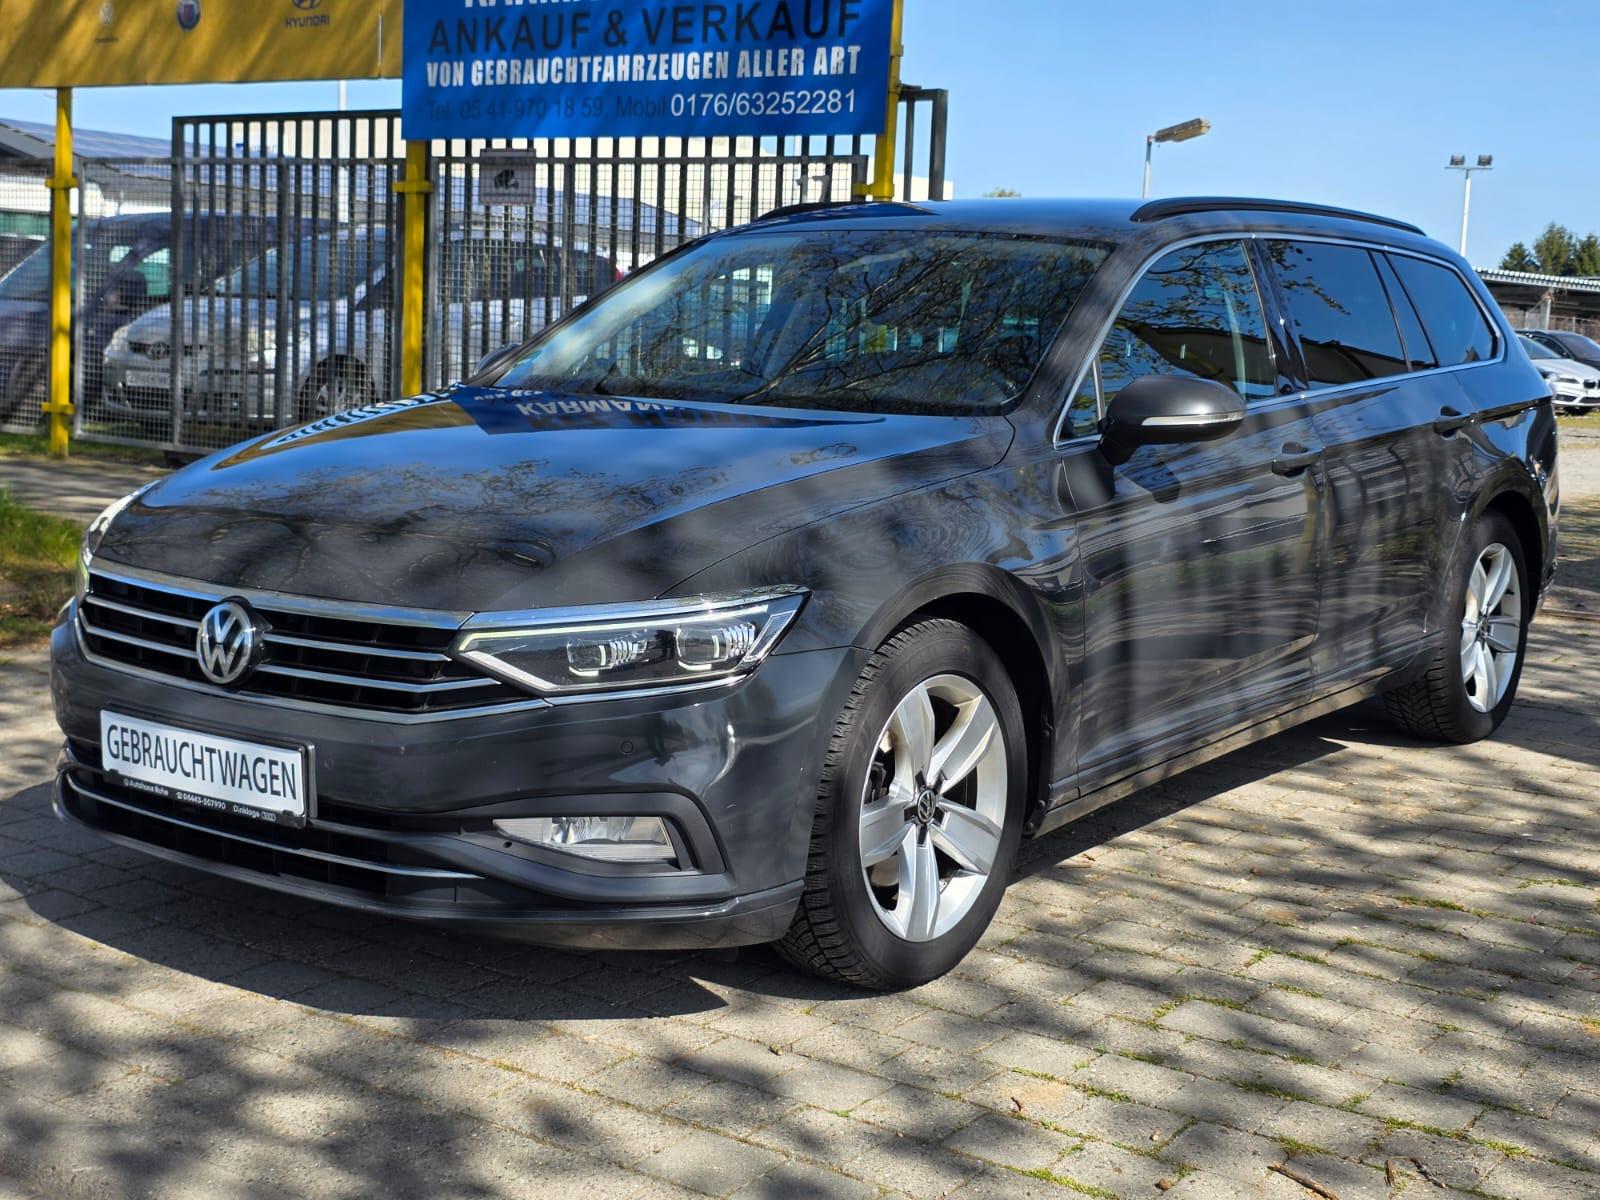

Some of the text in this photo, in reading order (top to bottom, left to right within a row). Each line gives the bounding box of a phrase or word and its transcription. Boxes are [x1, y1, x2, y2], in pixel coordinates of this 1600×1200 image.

[427, 0, 863, 55] ANKAUF & VERKAUF
[426, 44, 862, 87] VON GEBRAUCHTFAHRZEUGEN ALLER ART
[459, 98, 481, 120] 05
[670, 88, 856, 118] 0176/63252281
[106, 724, 298, 800] GEBRAUCHTWAGEN
